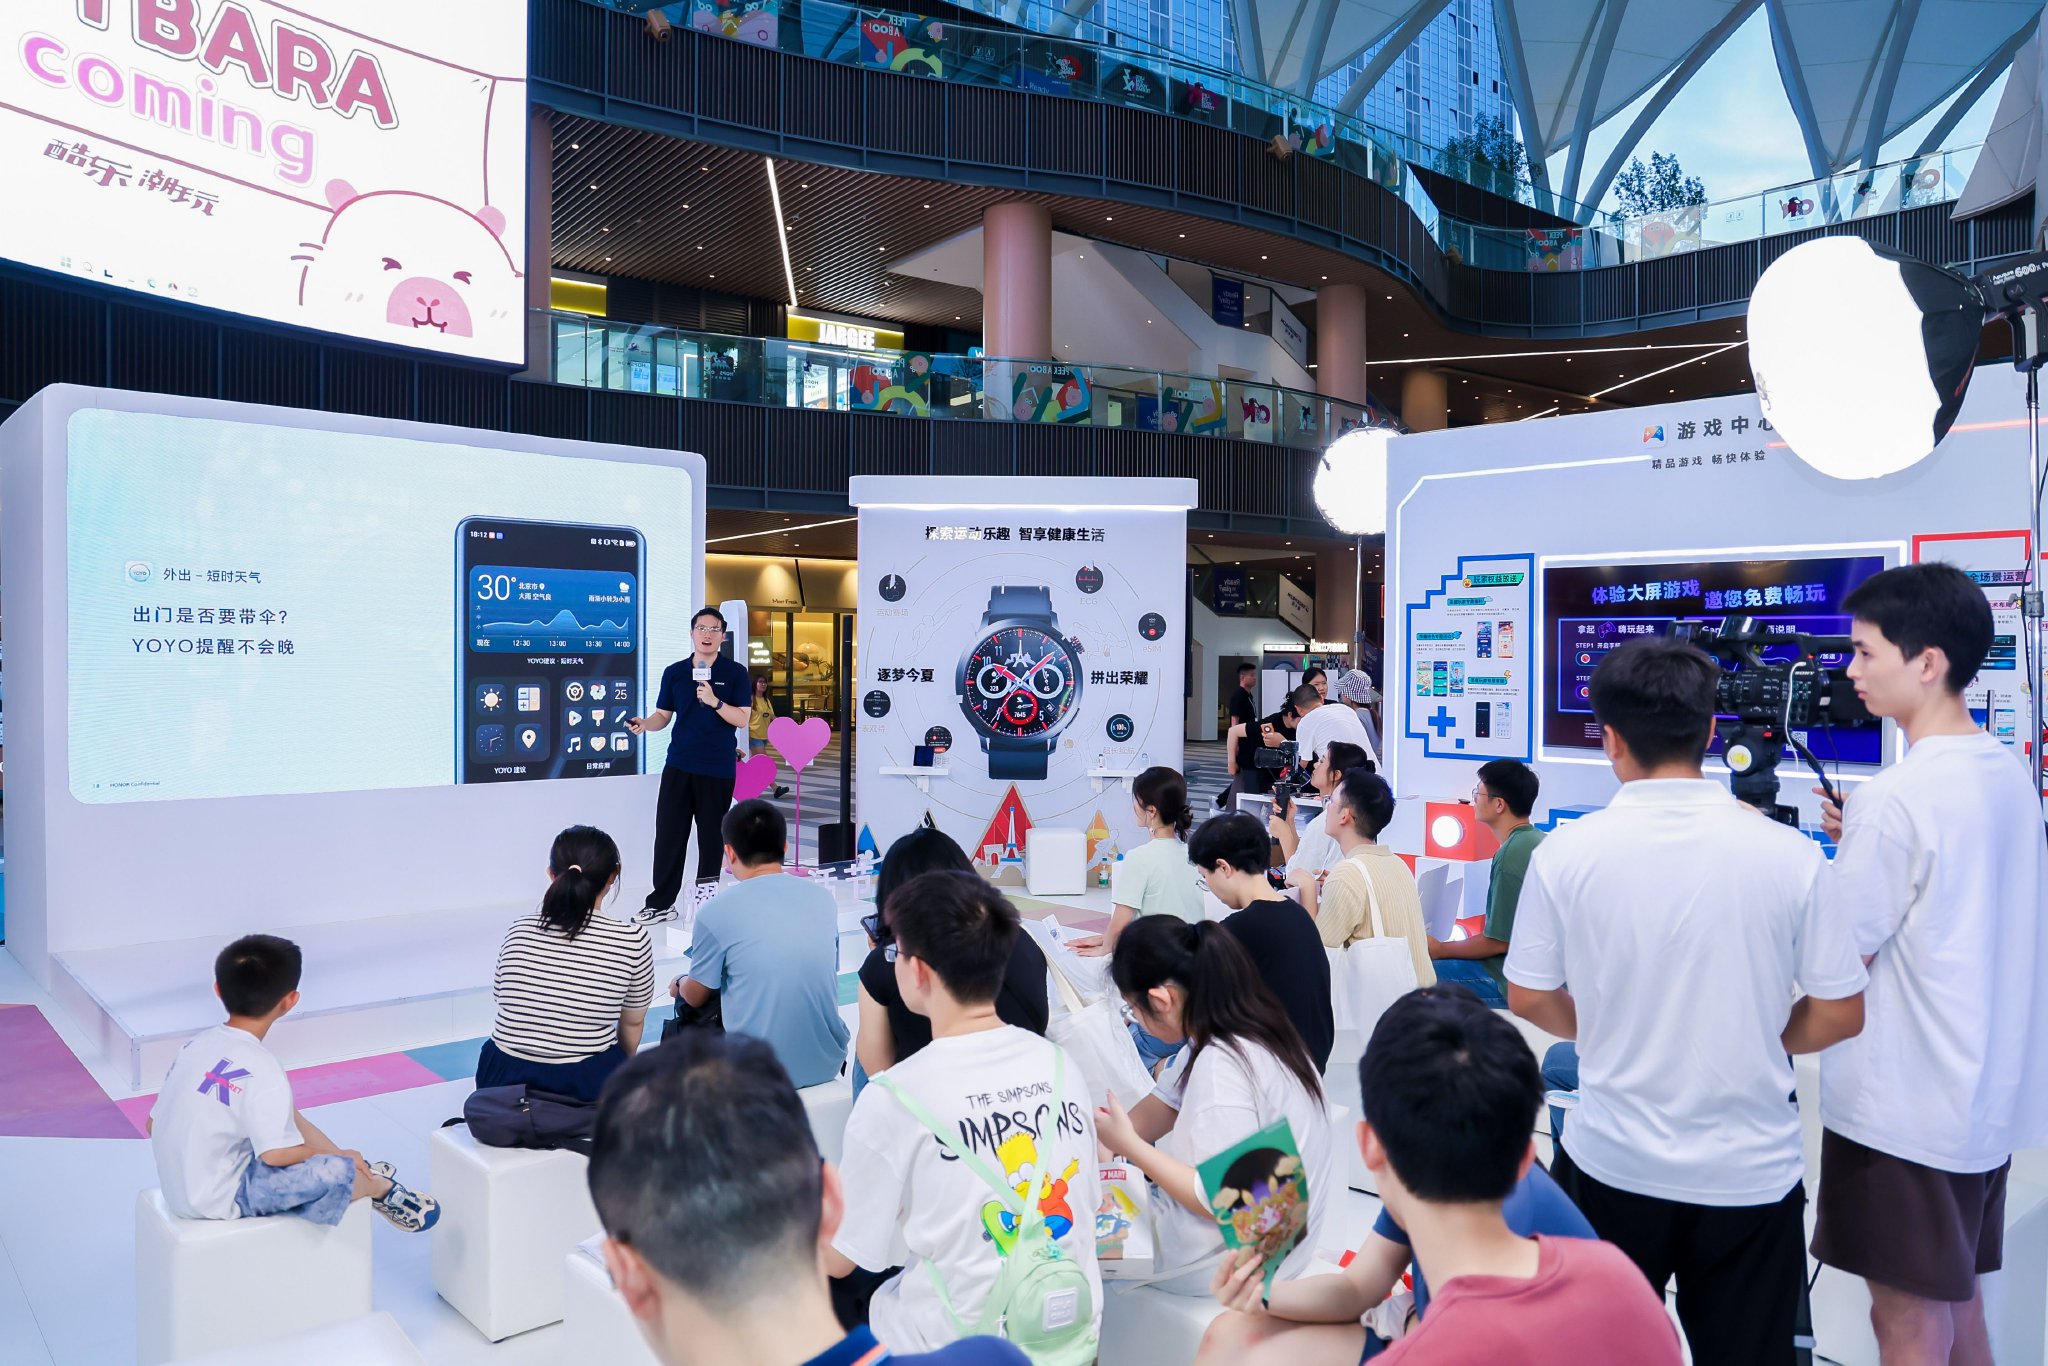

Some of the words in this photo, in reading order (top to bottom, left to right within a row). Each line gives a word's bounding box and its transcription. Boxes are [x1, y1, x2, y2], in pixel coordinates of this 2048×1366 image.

[78, 0, 398, 129] BARA
[22, 34, 316, 186] coming
[1652, 455, 1703, 469] 精品游戏
[1712, 449, 1766, 465] 畅快体验
[925, 525, 1010, 541] 探索运动乐趣
[1018, 526, 1105, 542] 智享健康生活
[163, 568, 192, 581] 外出
[207, 569, 262, 584] 短时天气
[1080, 597, 1098, 605] ECG
[1592, 579, 1700, 604] 体验大屏游戏
[1705, 583, 1826, 609] 邀您免费畅玩
[133, 606, 288, 625] 出门是否要带伞?
[1578, 625, 1595, 634] 拿起
[1618, 625, 1654, 634] 嗨玩起来
[132, 638, 295, 656] YOYO提醒不会晚
[513, 639, 531, 647] 12:30
[585, 640, 602, 648] 13:30
[614, 640, 631, 648] 14:00
[877, 667, 935, 683] 逐梦今夏
[1090, 670, 1149, 685] 拼出荣耀
[614, 689, 628, 700] 25
[965, 1093, 992, 1109] THE
[997, 1081, 1053, 1103] SIMPSONS
[1108, 1170, 1126, 1180] MART
